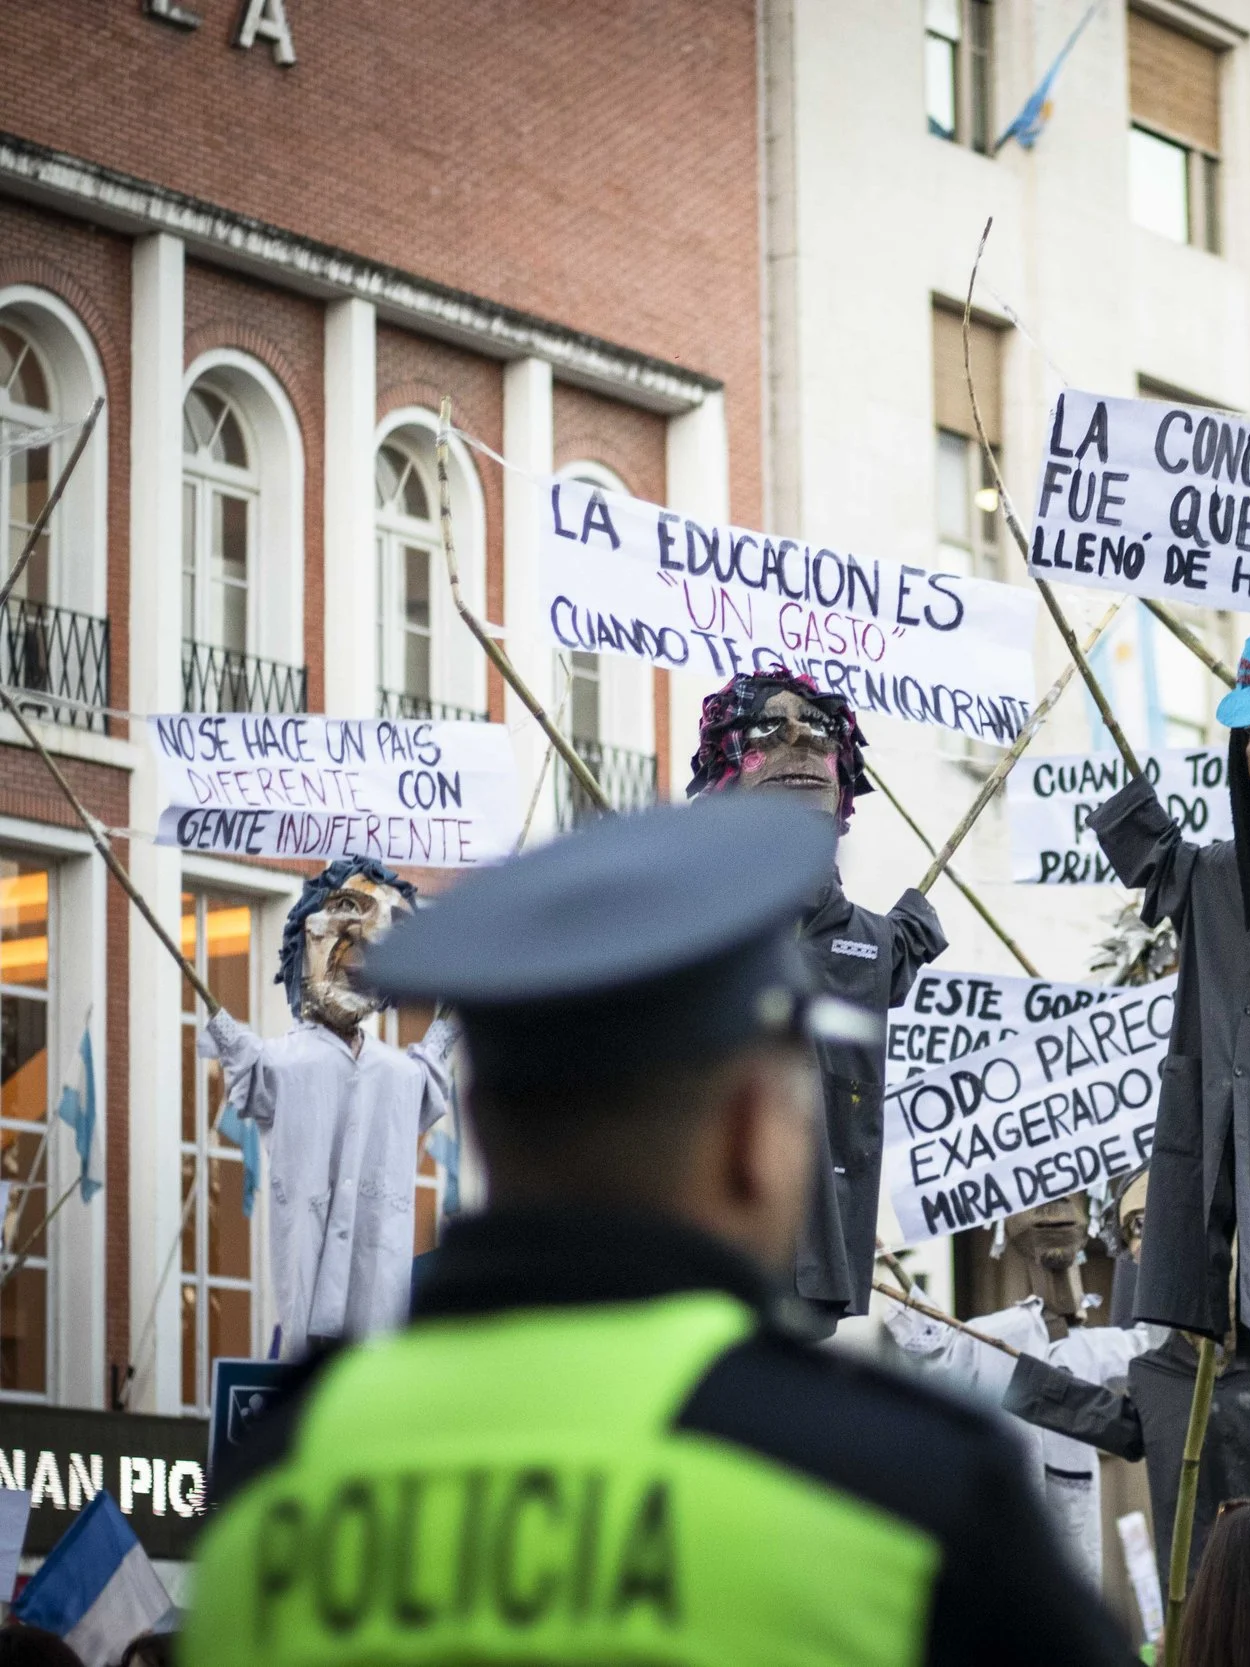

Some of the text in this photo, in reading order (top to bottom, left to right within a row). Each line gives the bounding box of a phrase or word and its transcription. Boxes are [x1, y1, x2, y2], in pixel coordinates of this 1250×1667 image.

[1049, 392, 1109, 463] LA
[1038, 462, 1129, 526] FUE
[551, 483, 964, 631] LA EDUCACION ES
[1031, 526, 1153, 580] LLENÓ
[1164, 544, 1212, 590] DE
[550, 595, 689, 666] CUANDO
[156, 716, 442, 767] NO SE HACE UN PAIS
[187, 768, 462, 812] DIFERENTE CON
[1033, 757, 1161, 798] CUANO
[177, 809, 478, 863] GENTE INDIFERENTE
[914, 977, 1002, 1021] ESTE
[884, 990, 1176, 1139] TODO PAREC
[910, 1068, 1153, 1187] EXAGERADO
[921, 1173, 1012, 1235] MIRA
[1013, 1135, 1132, 1206] DESDE
[252, 1464, 680, 1643] POLICIA
